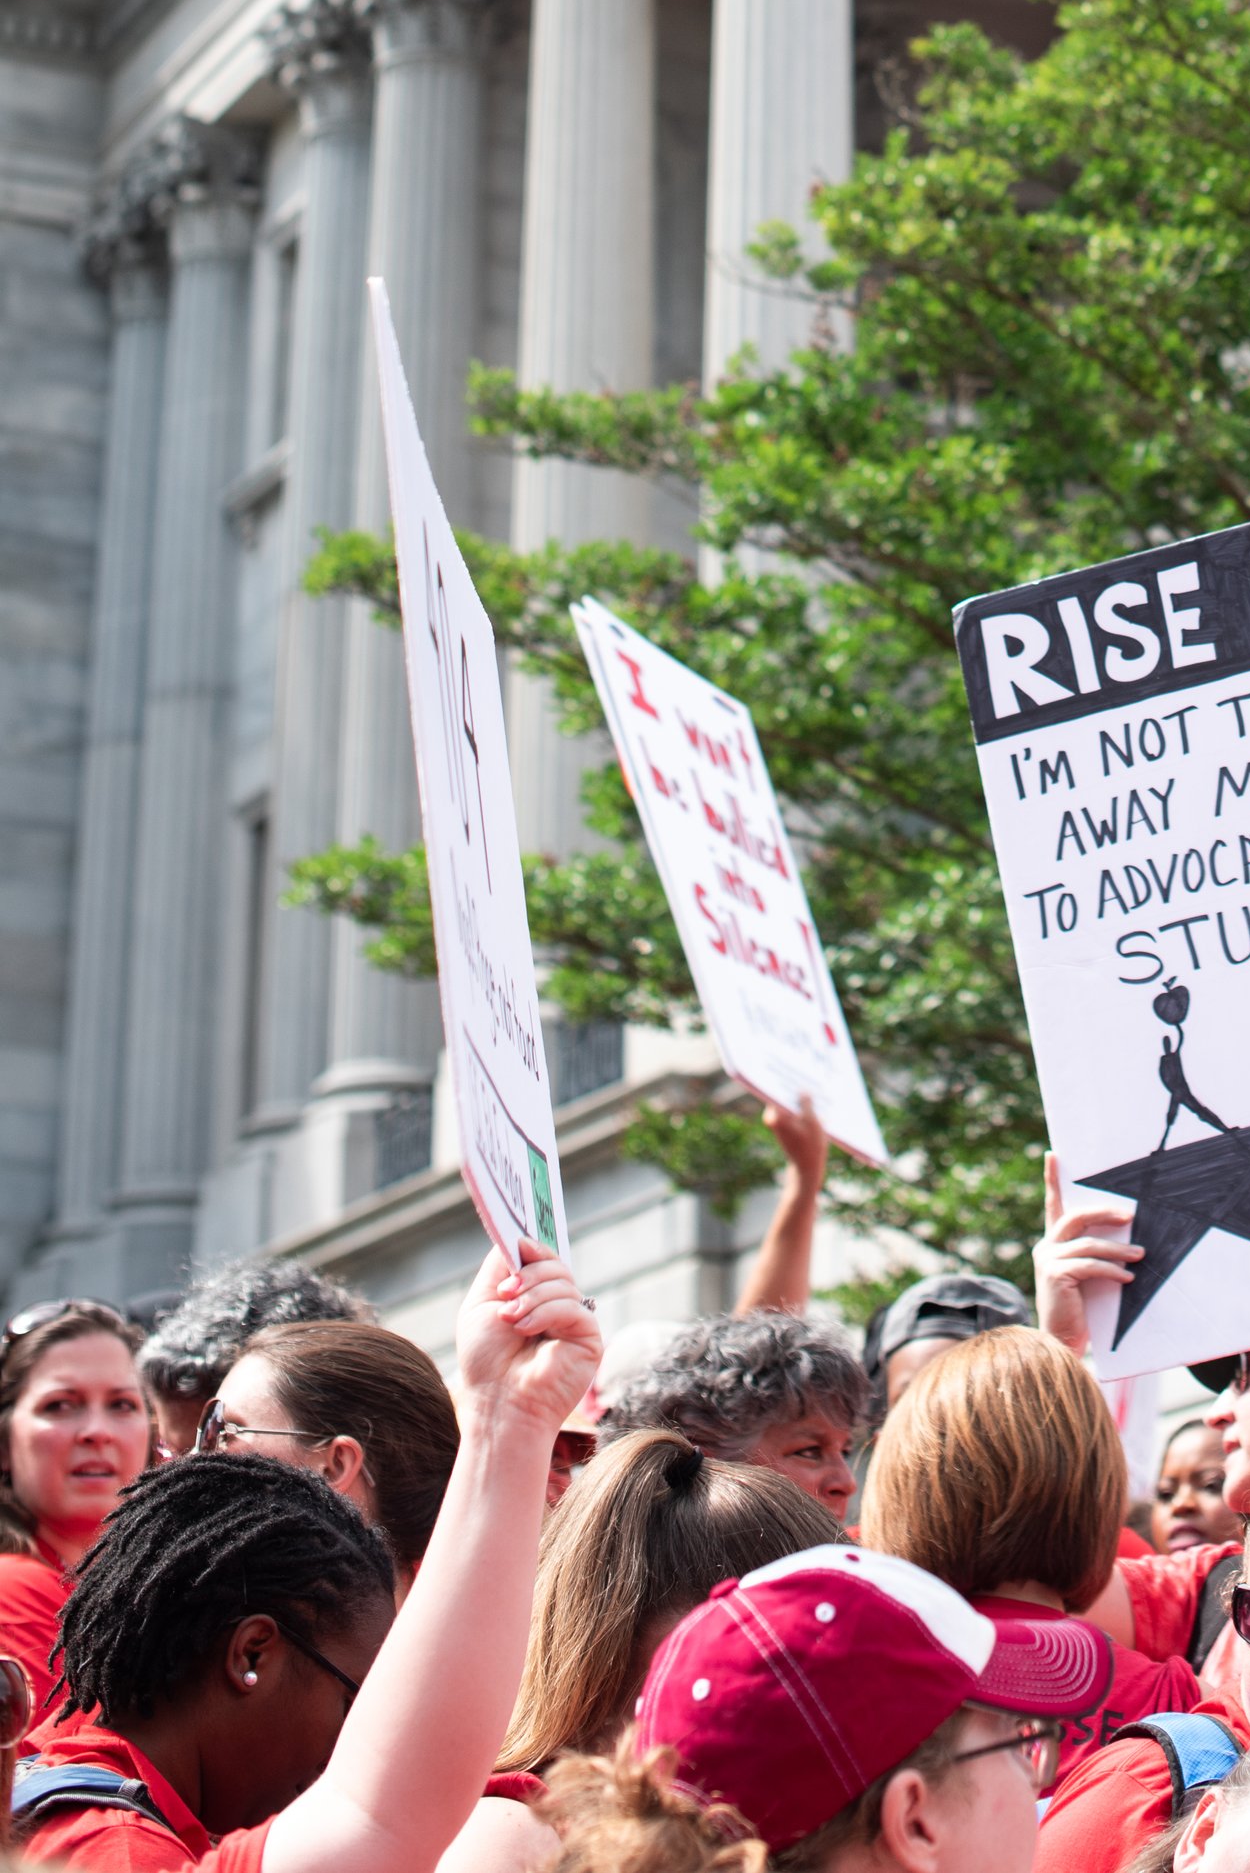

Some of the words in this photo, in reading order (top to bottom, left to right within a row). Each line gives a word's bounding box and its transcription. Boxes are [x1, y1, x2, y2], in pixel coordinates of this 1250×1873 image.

[616, 648, 660, 720] I
[981, 562, 1216, 718] RISE
[423, 517, 492, 895] 404
[1010, 749, 1075, 800] I'M
[1099, 706, 1193, 777] NOT
[638, 734, 688, 813] be
[690, 766, 790, 880] bullied
[1056, 778, 1175, 861] AWAY
[709, 845, 766, 914] into
[1023, 883, 1078, 939] TO
[510, 977, 541, 1084] found
